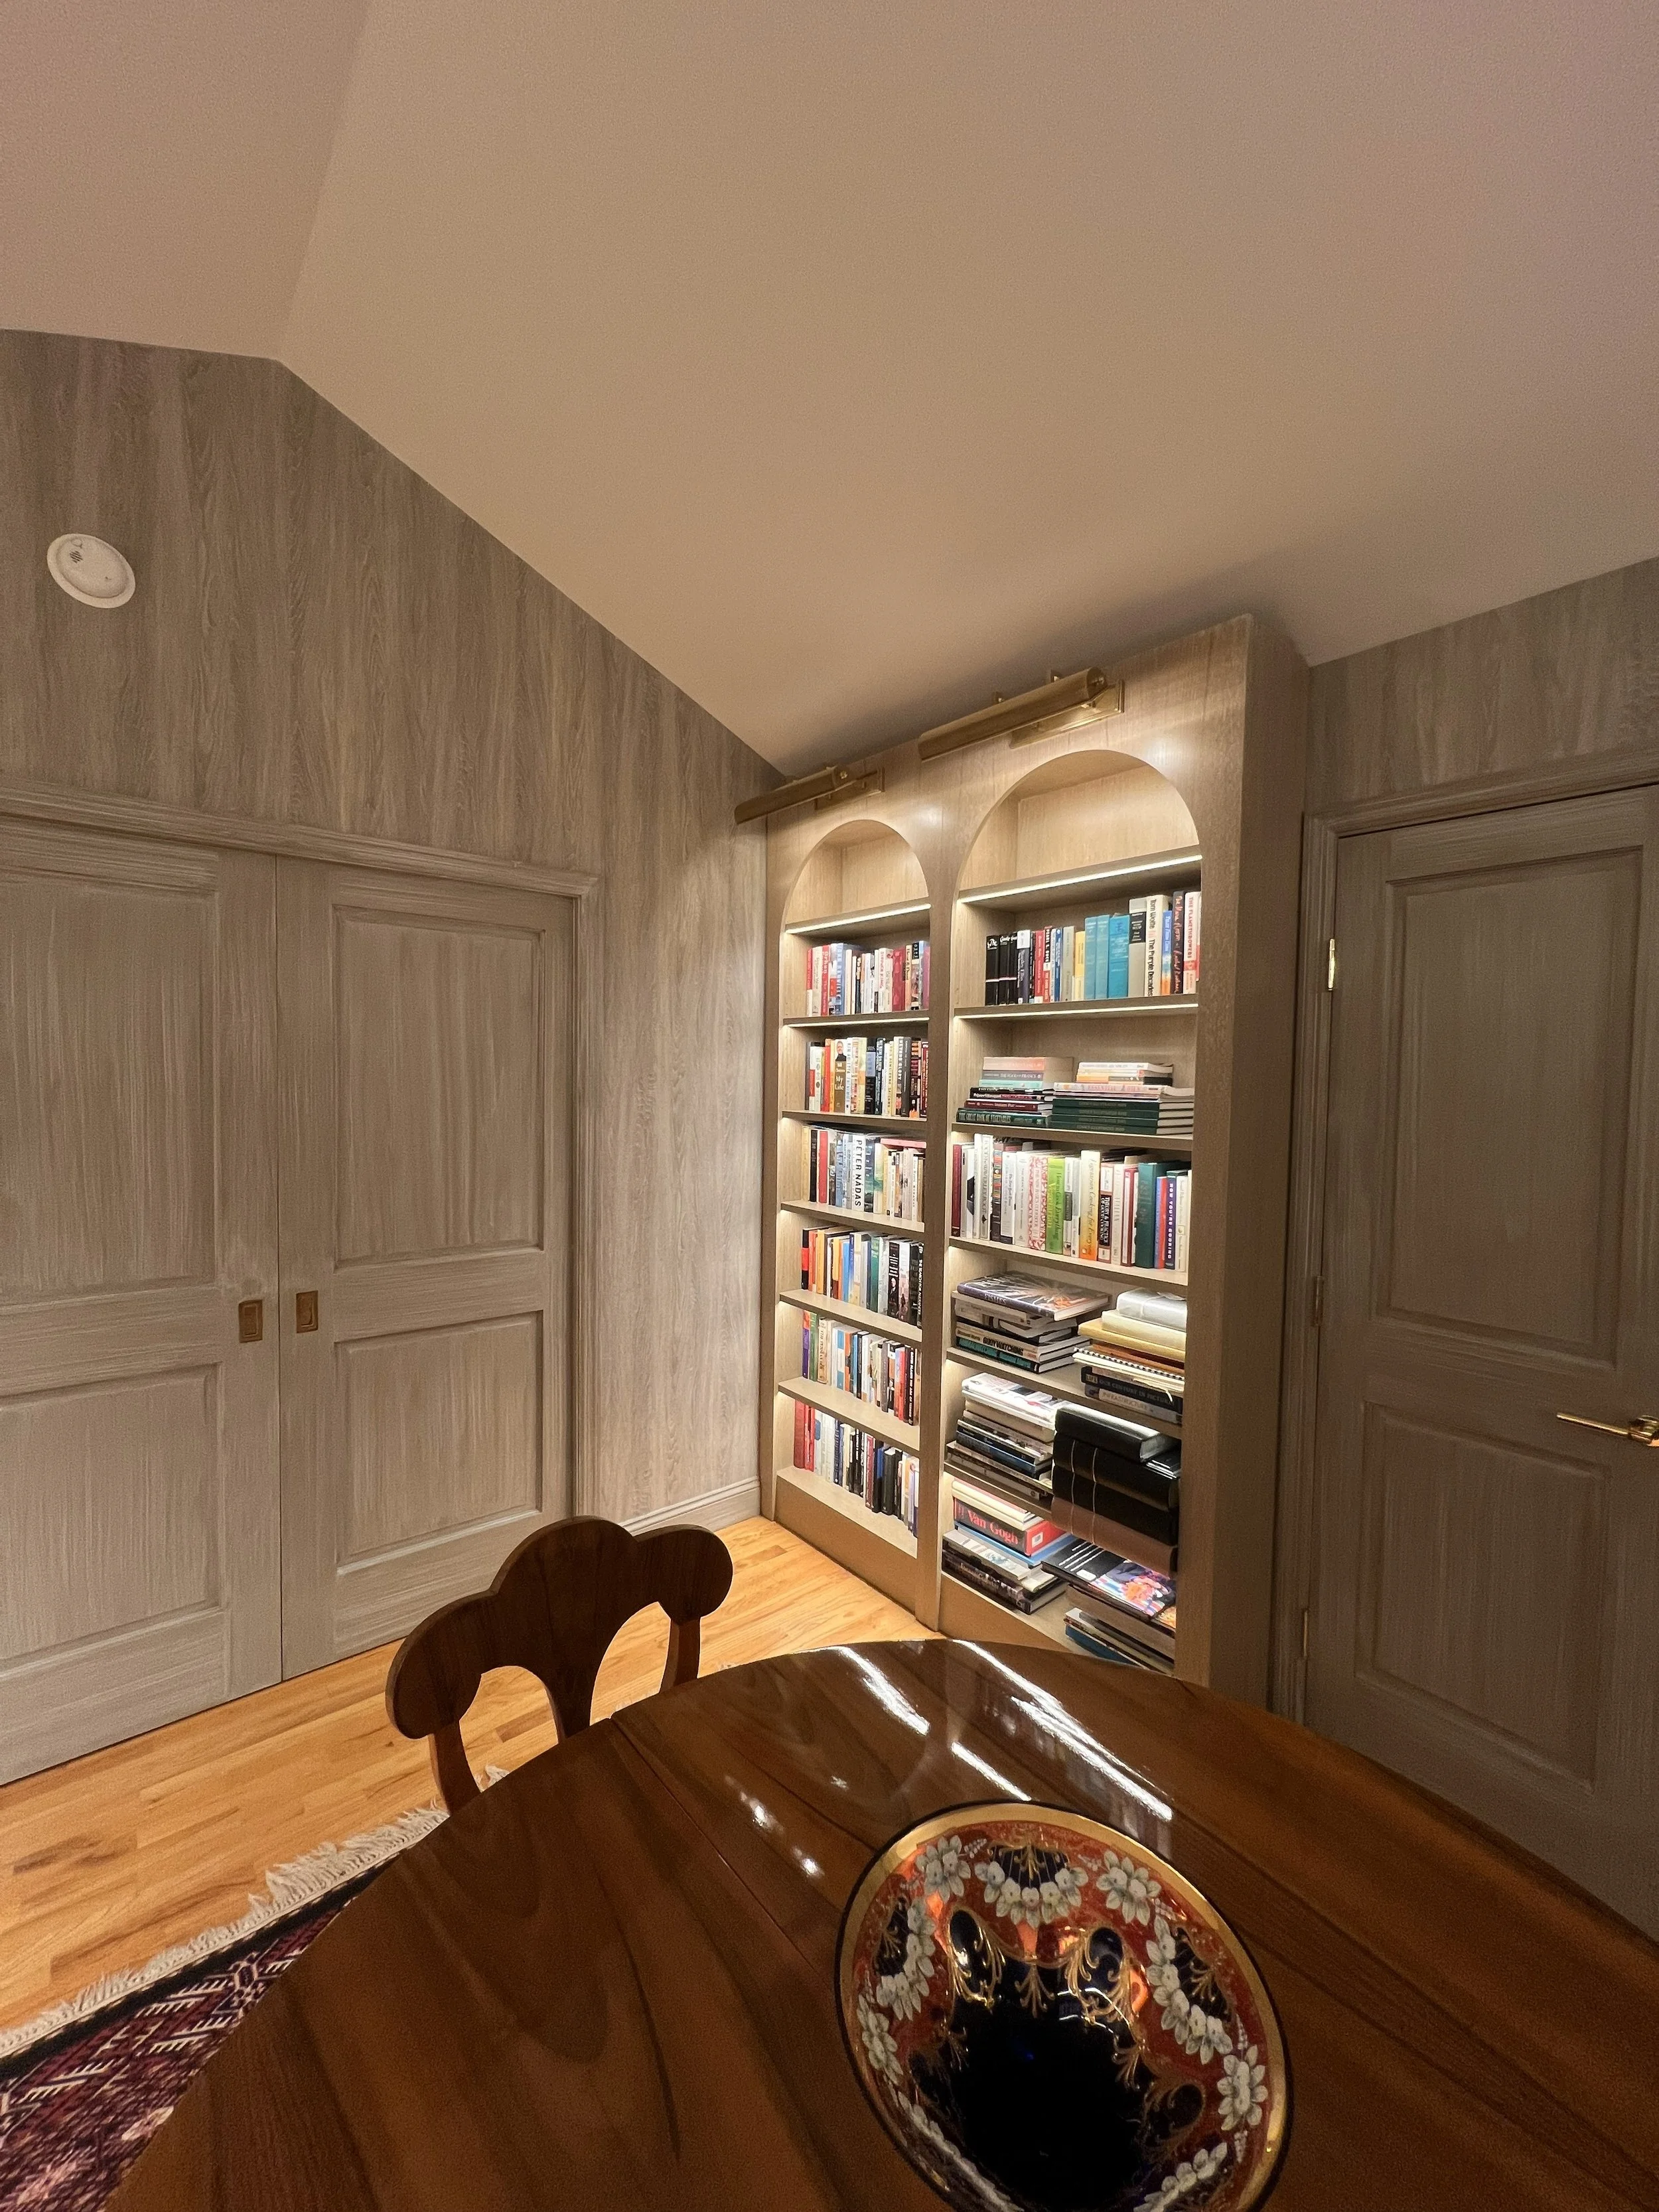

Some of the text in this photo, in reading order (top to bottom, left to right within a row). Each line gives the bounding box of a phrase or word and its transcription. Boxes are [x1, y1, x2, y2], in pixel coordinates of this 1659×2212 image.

[835, 1076, 843, 1085] My
[855, 1139, 864, 1207] PÉTER NÁDAS
[1088, 1159, 1096, 1190] Vegetarian
[1047, 1181, 1056, 1228] Vegetarian
[1053, 1206, 1062, 1240] Everything
[967, 1509, 1019, 1545] Van Gogh
